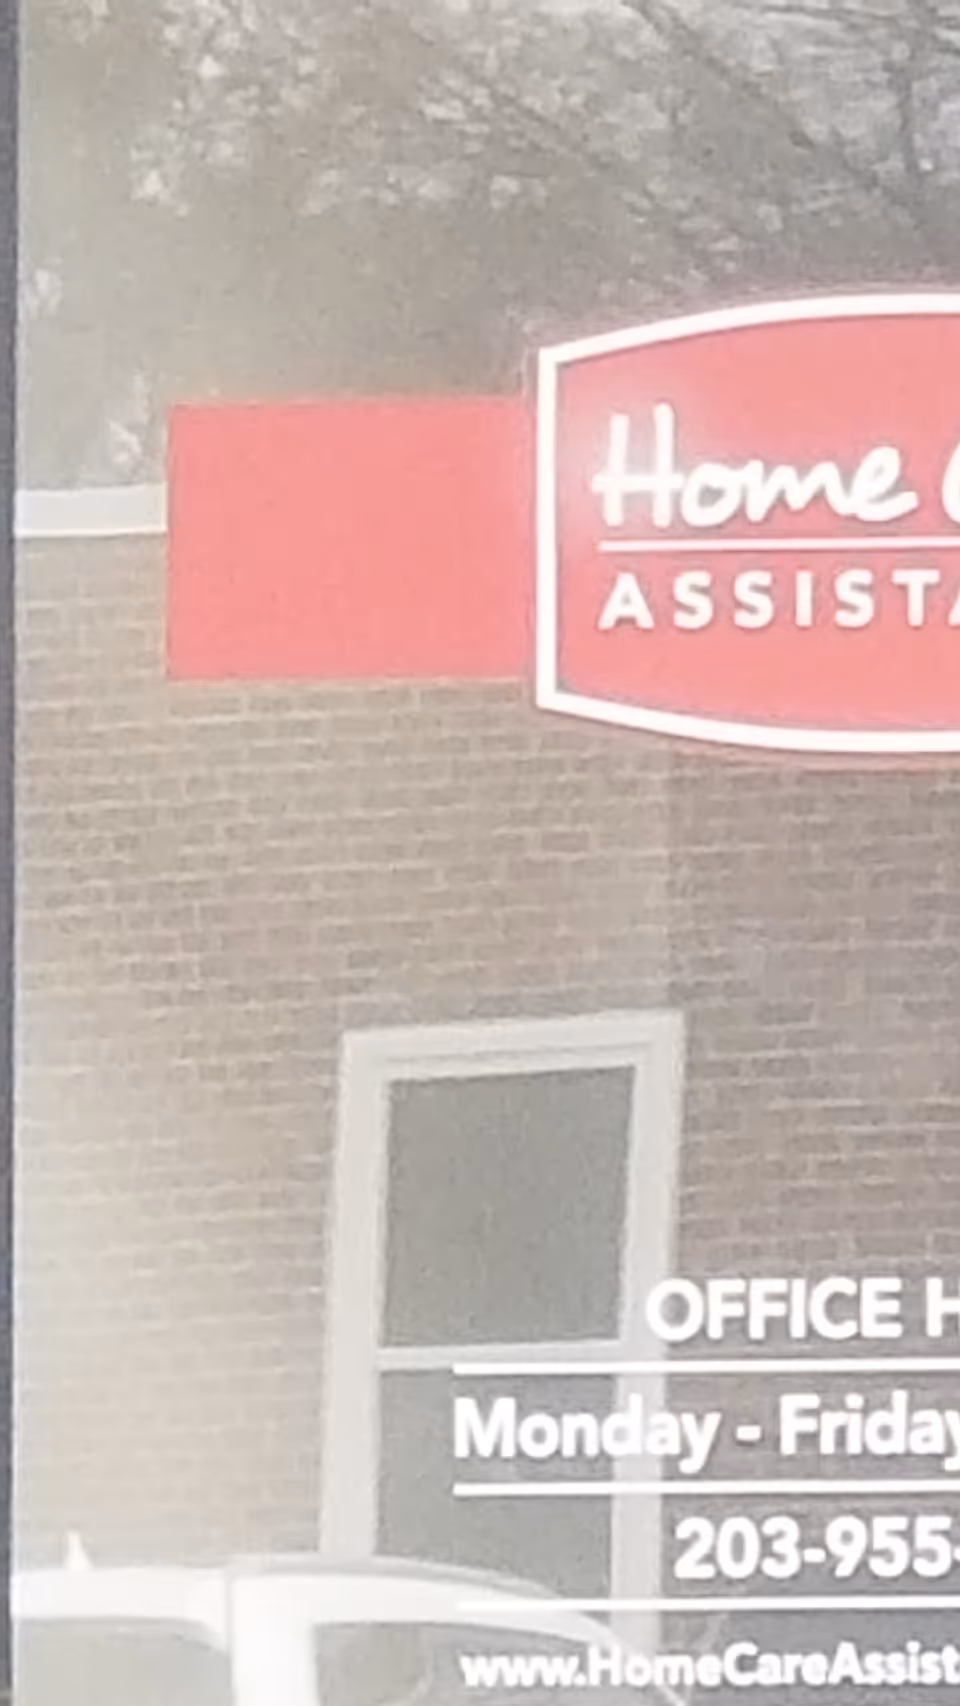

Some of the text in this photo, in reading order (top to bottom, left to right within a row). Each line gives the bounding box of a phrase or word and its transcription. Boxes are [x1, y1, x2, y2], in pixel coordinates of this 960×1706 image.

[592, 403, 918, 527] Home
[645, 1277, 903, 1341] OFFICE
[453, 1395, 721, 1473] Monday
[737, 1425, 762, 1441] -
